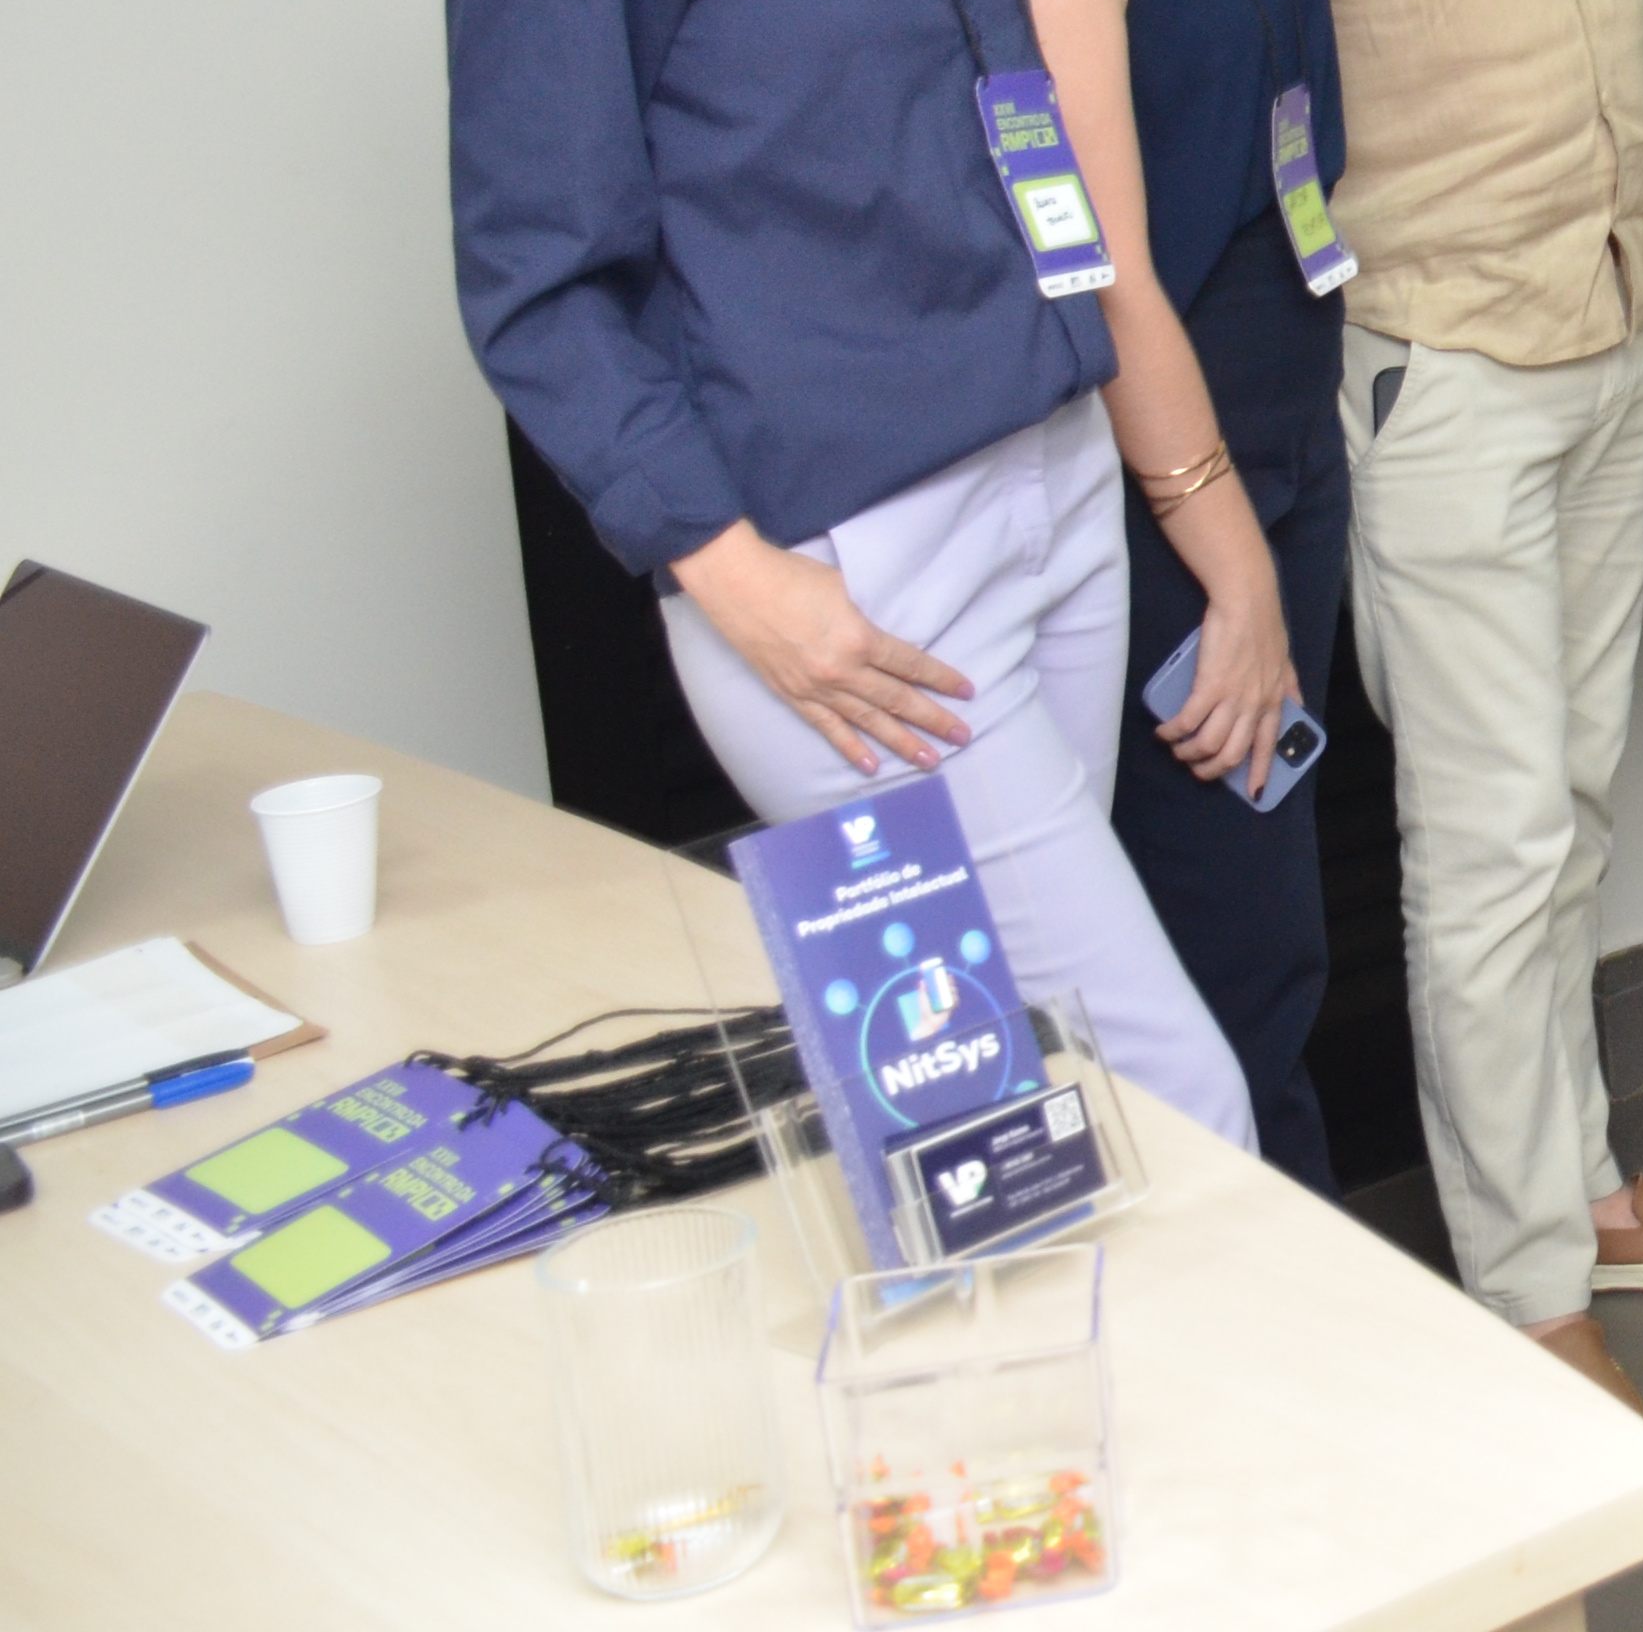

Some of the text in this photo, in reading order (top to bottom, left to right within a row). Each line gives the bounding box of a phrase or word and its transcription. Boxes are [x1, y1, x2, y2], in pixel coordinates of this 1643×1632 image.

[797, 865, 969, 938] Propriedade Intelectual
[881, 1032, 1000, 1096] NitSys
